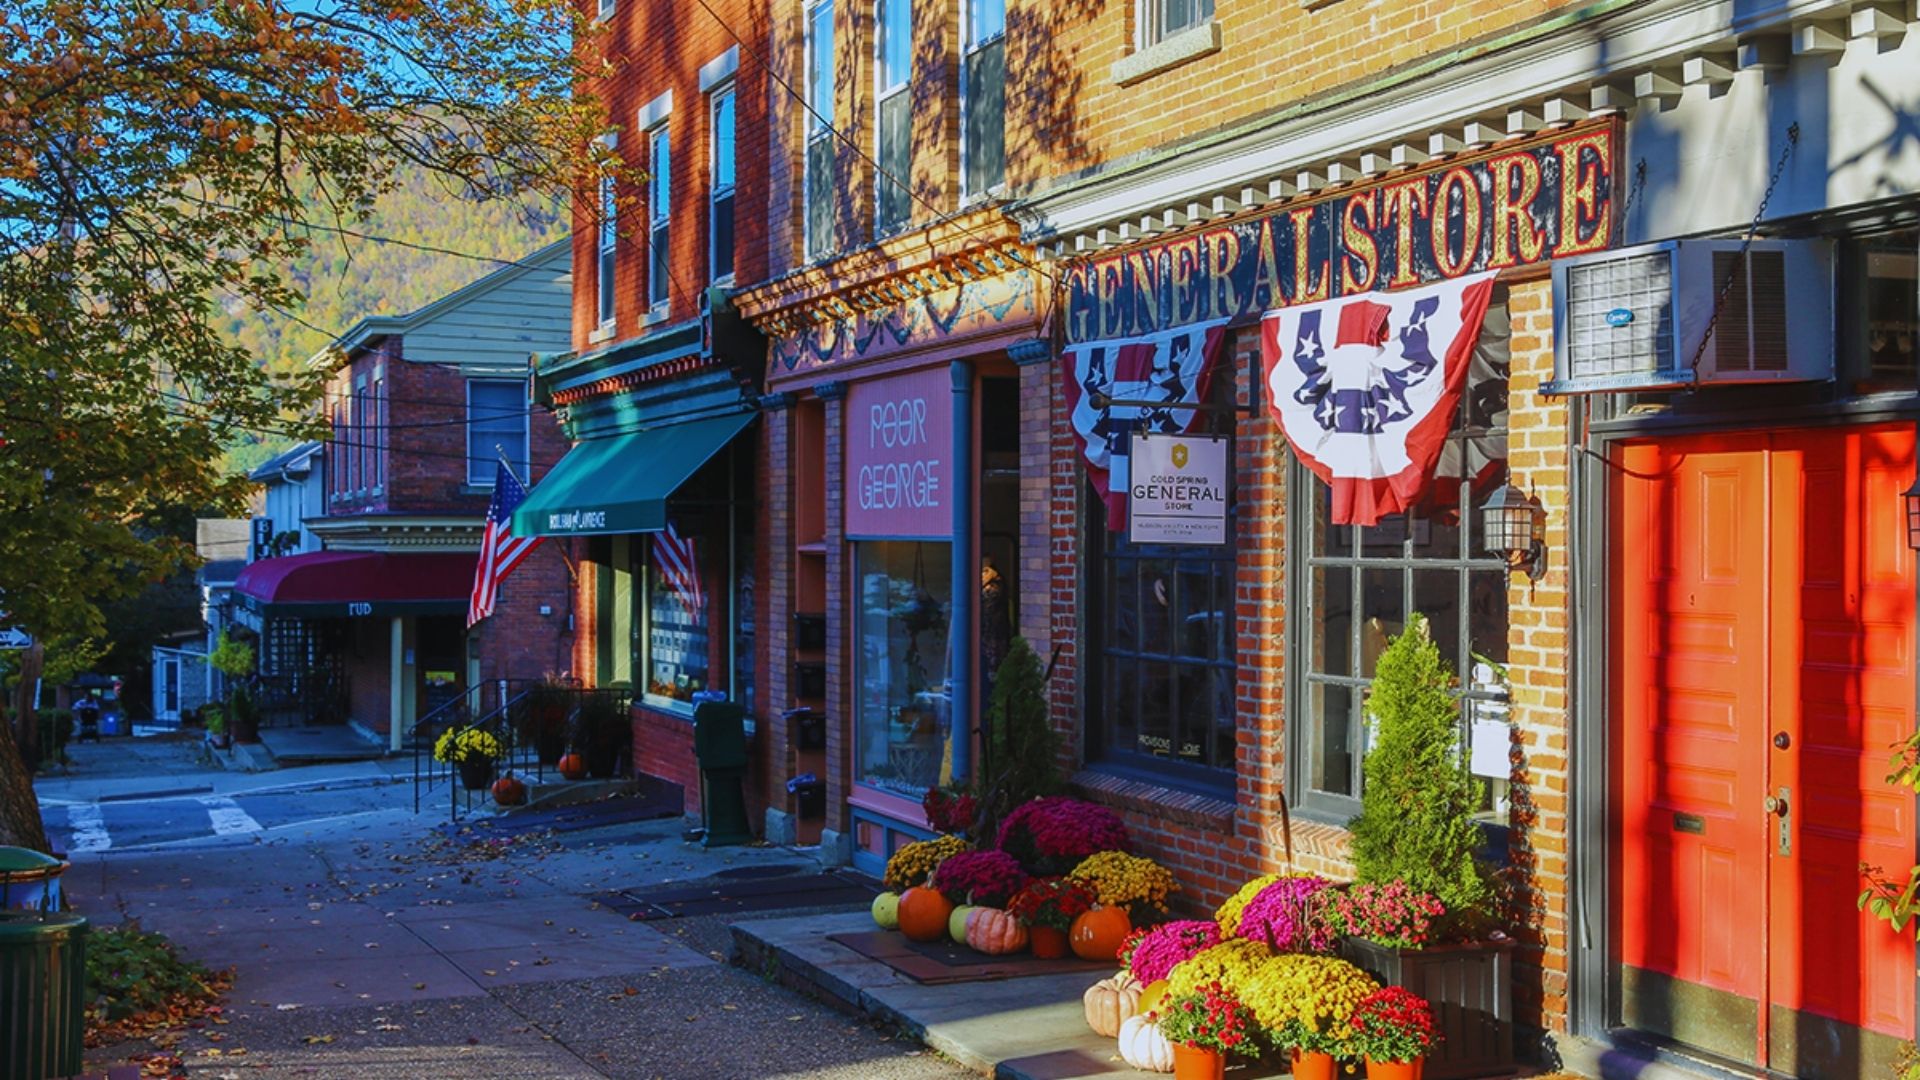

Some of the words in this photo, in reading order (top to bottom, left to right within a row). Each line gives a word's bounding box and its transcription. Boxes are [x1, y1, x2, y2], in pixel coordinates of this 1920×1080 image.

[1064, 206, 1330, 344] GENERAL
[1340, 129, 1612, 296] STORE
[870, 398, 926, 448] POOR
[858, 460, 940, 510] GEORGE
[1133, 485, 1224, 502] GENERAL
[1150, 475, 1175, 484] COLD
[1176, 476, 1208, 485] SPRING
[1164, 502, 1193, 511] STORE
